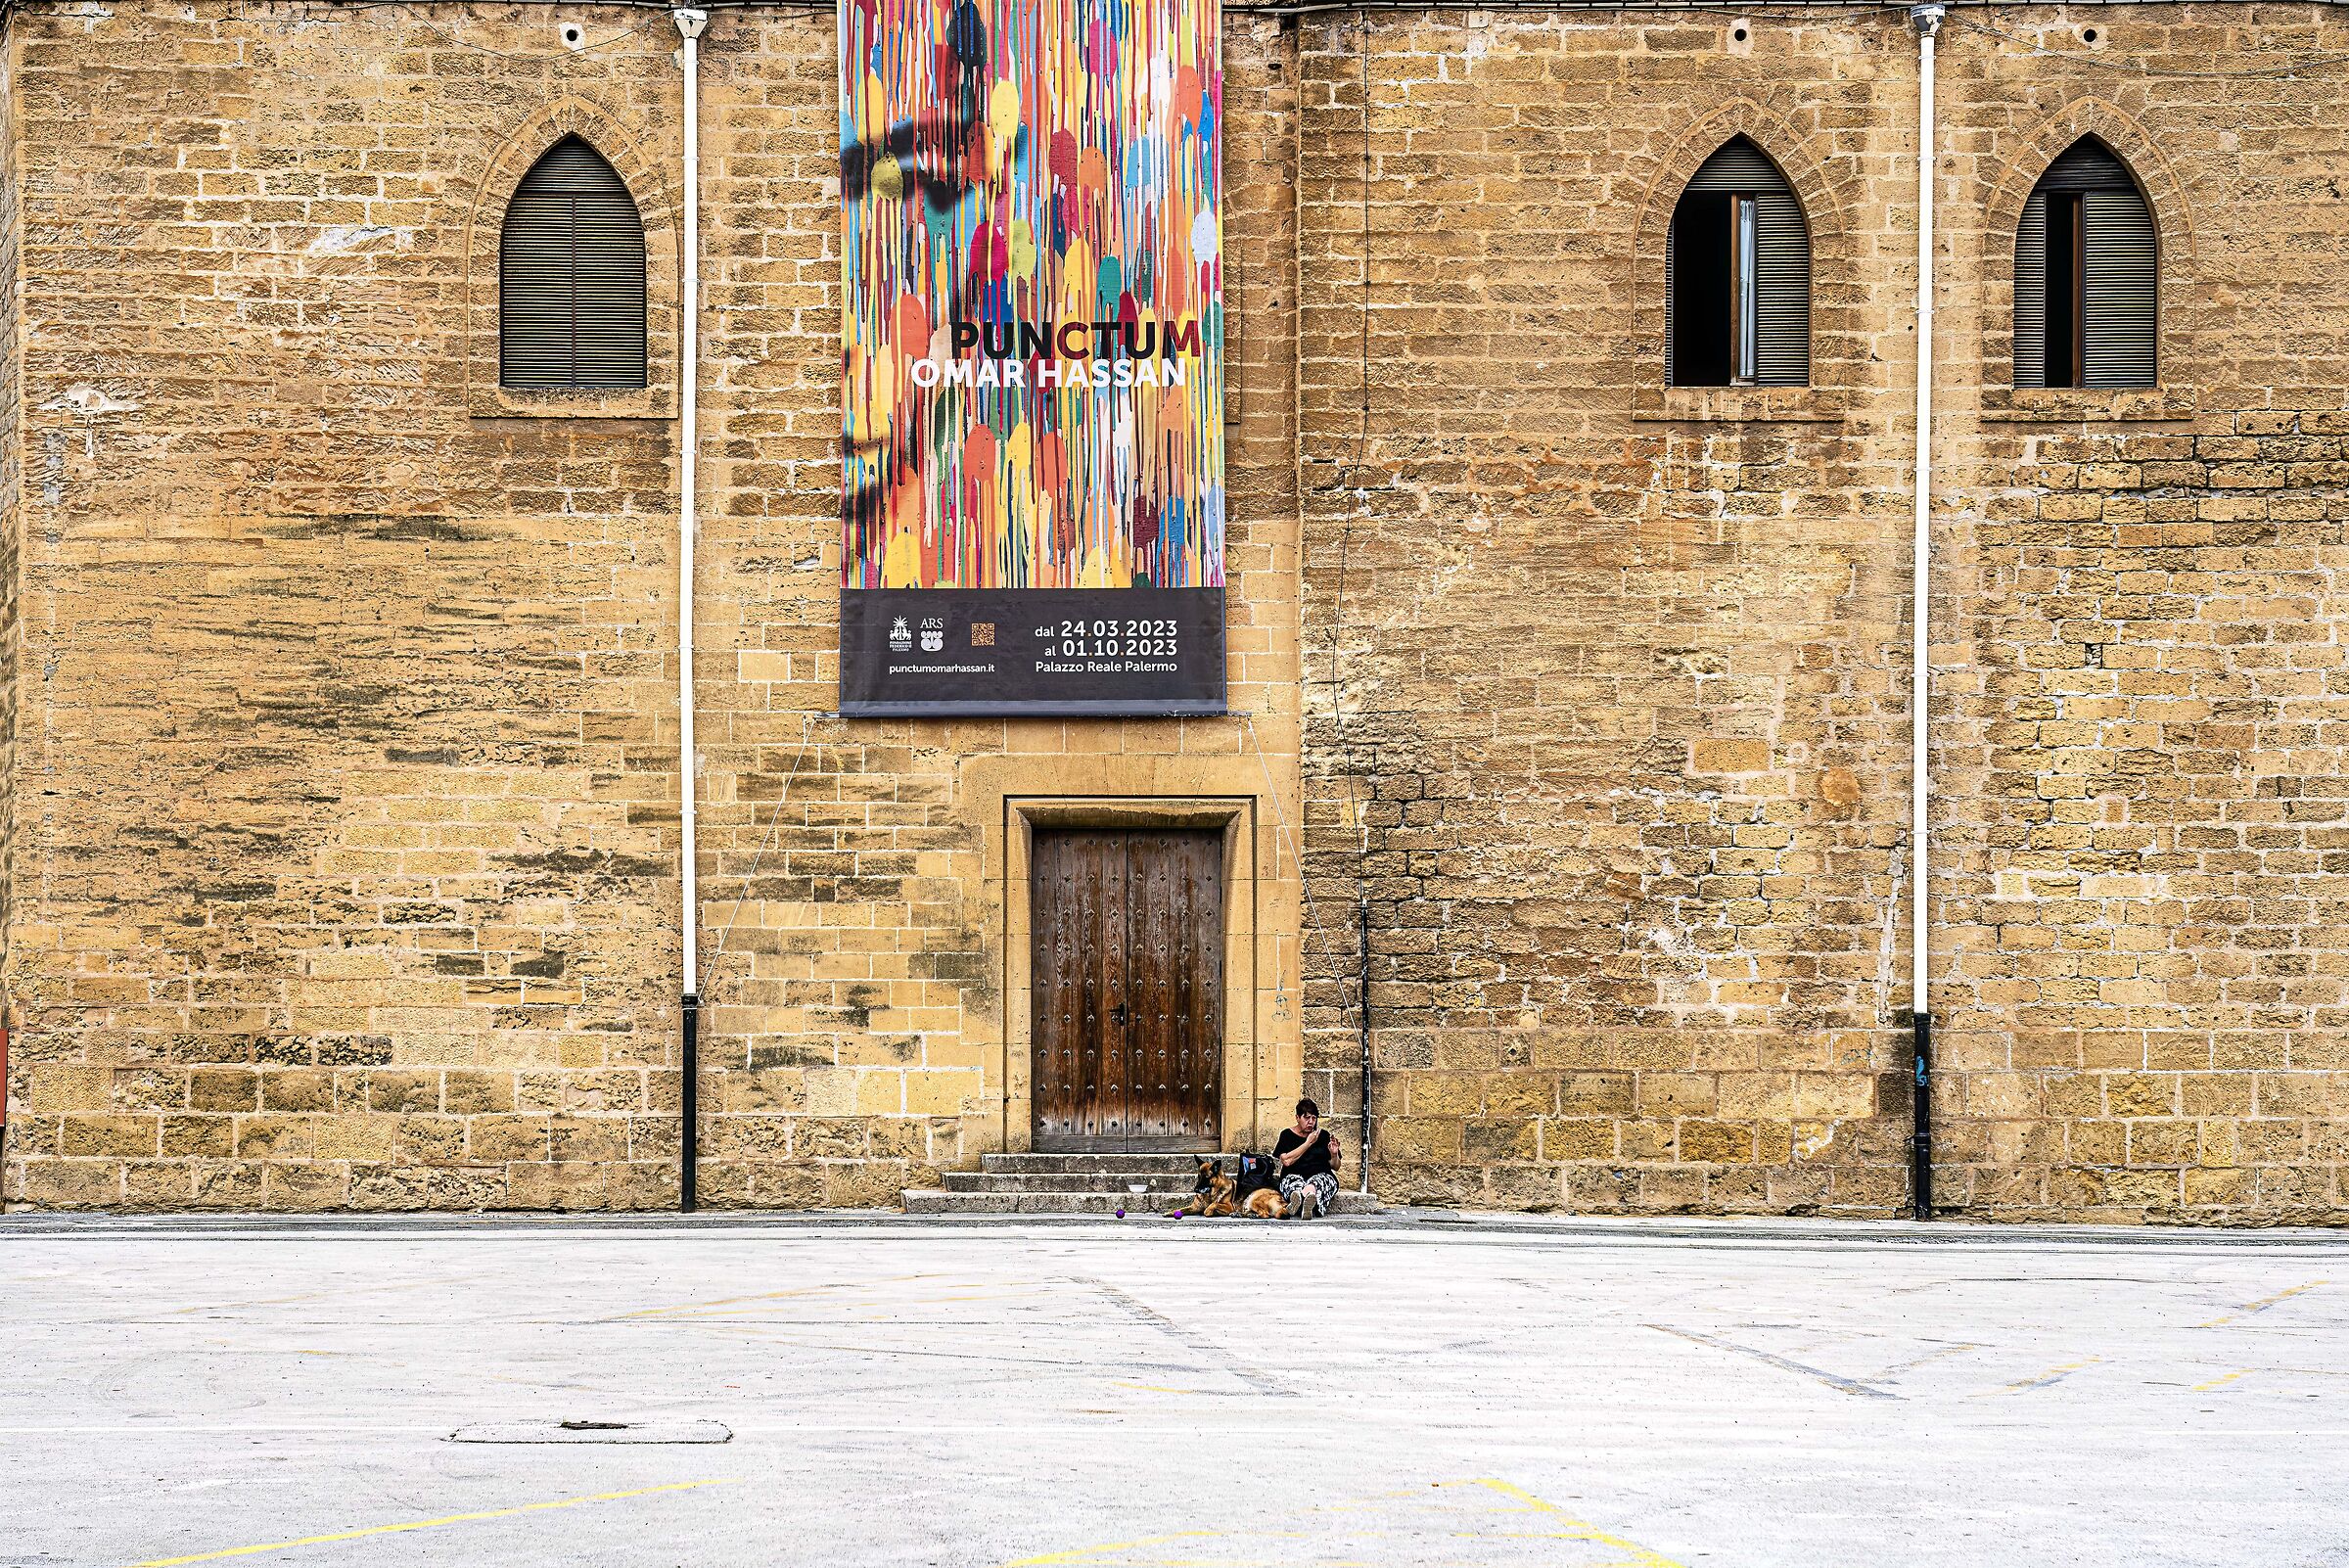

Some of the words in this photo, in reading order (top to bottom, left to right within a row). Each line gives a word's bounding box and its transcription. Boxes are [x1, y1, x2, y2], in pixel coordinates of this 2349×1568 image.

[951, 320, 1200, 359] PUNCTUM
[910, 358, 1026, 388] OMAR
[1037, 358, 1185, 388] HASSAN
[919, 618, 944, 629] ARS
[1035, 625, 1055, 637] dal
[1061, 620, 1177, 637] 24.03.2023
[1044, 645, 1056, 657] al
[1062, 639, 1177, 657] 01.10.2023
[889, 664, 995, 675] punctumomarhassan.it
[1036, 661, 1084, 672] Palazzo
[1087, 661, 1123, 672] Reale
[1125, 661, 1177, 672] Palermo
